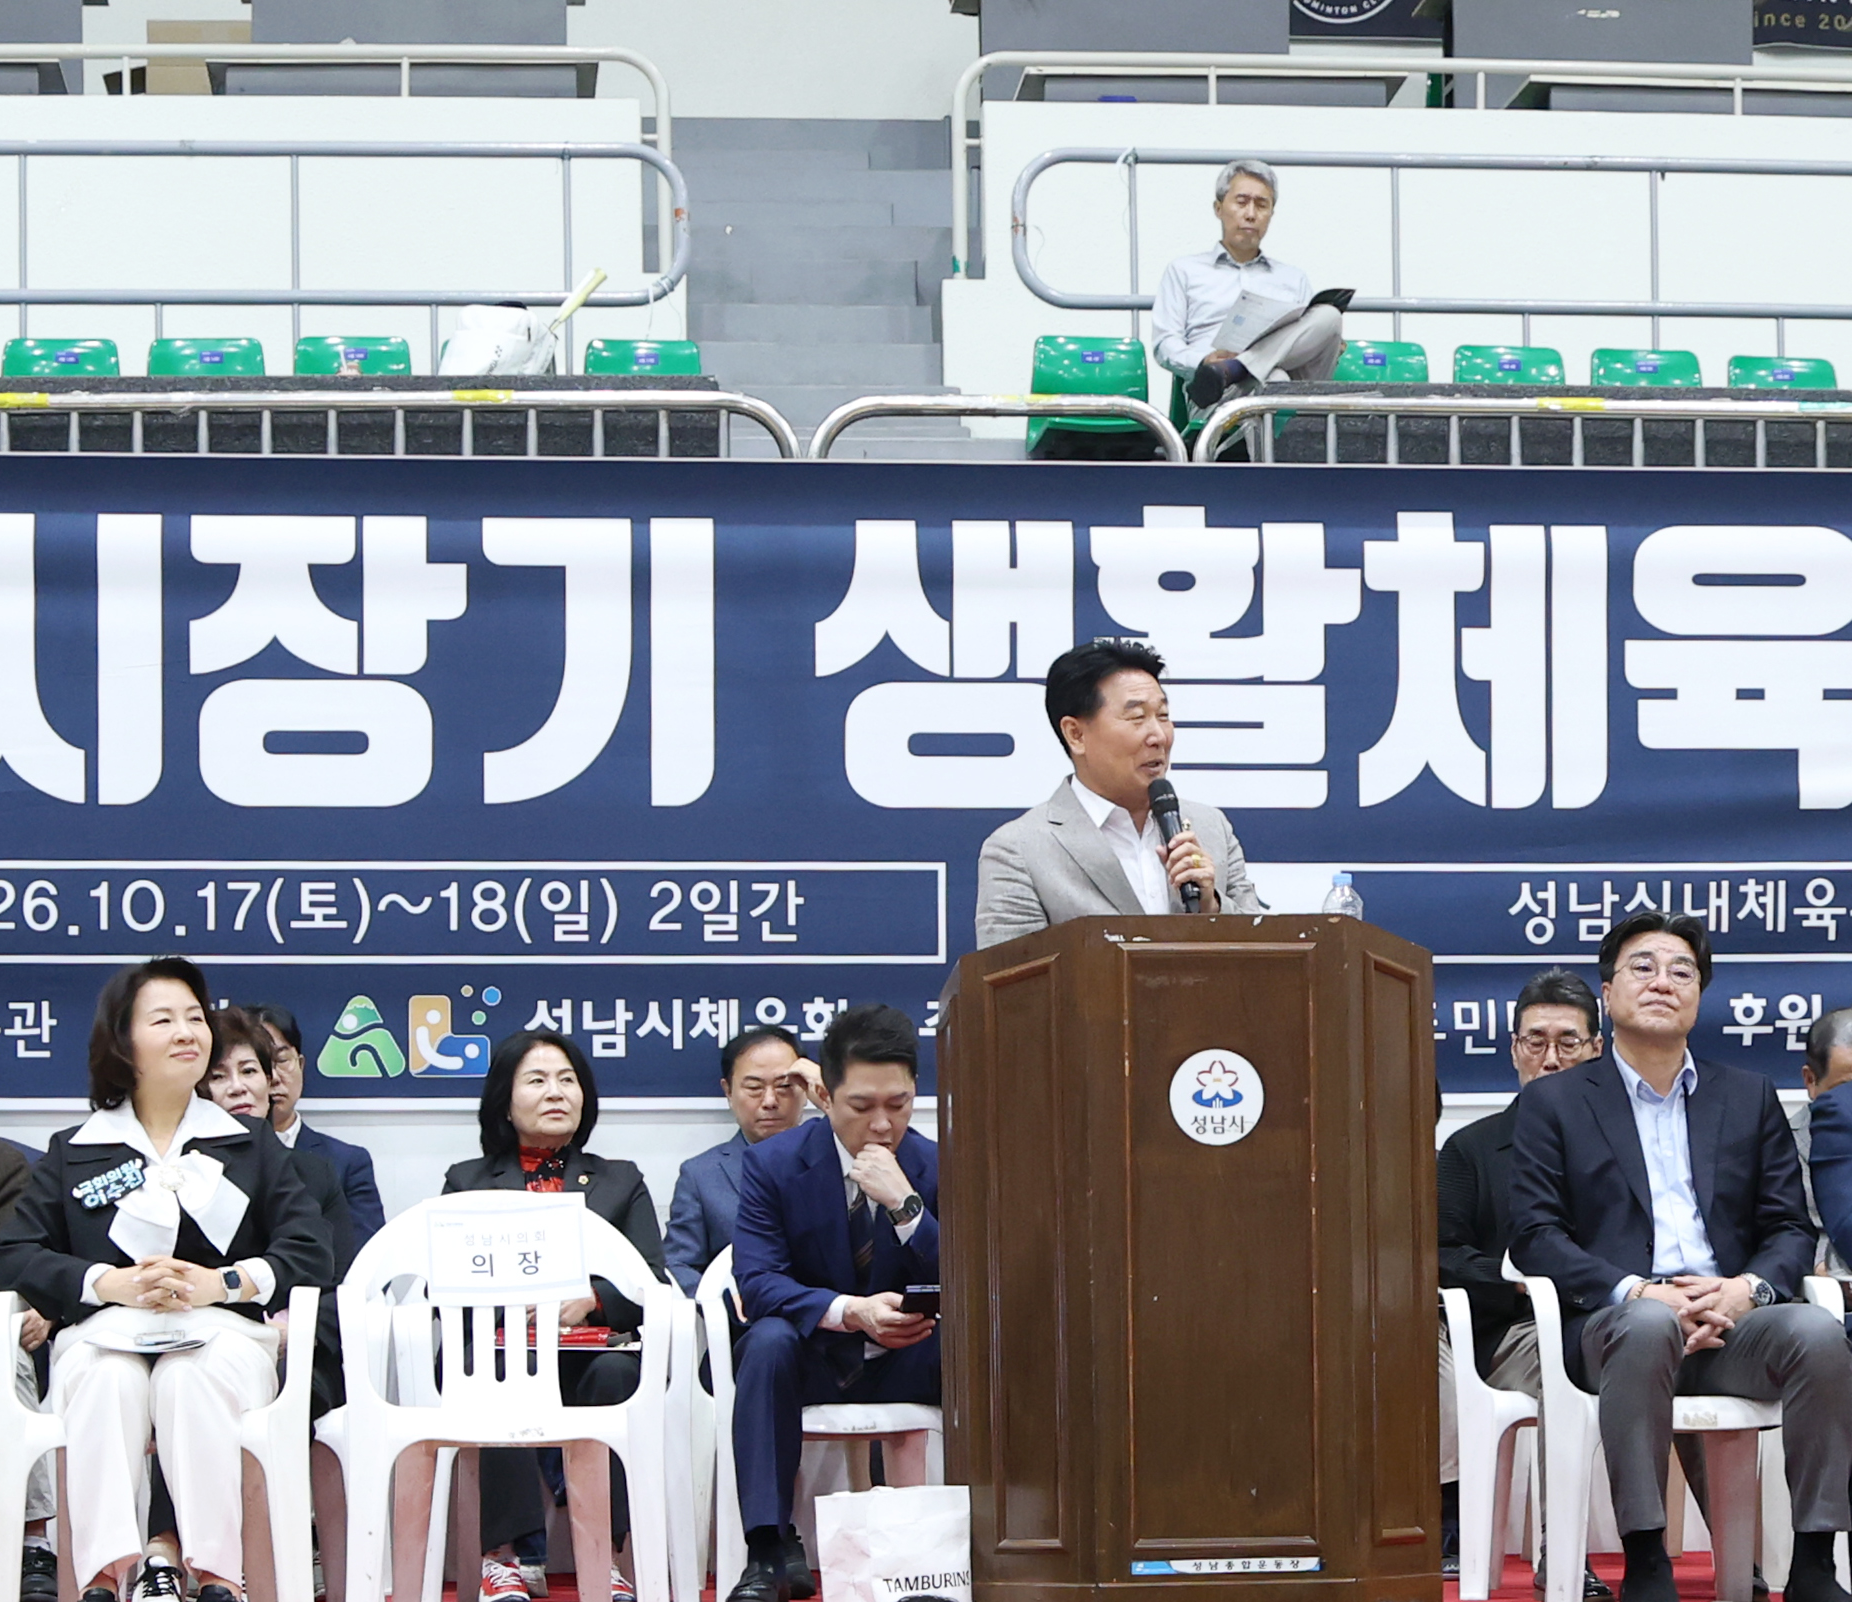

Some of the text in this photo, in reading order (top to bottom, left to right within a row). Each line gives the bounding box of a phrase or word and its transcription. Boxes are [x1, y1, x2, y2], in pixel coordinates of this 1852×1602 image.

[1753, 10, 1806, 28] ince
[649, 880, 806, 943] 2일간
[1190, 1115, 1246, 1136] 성남시
